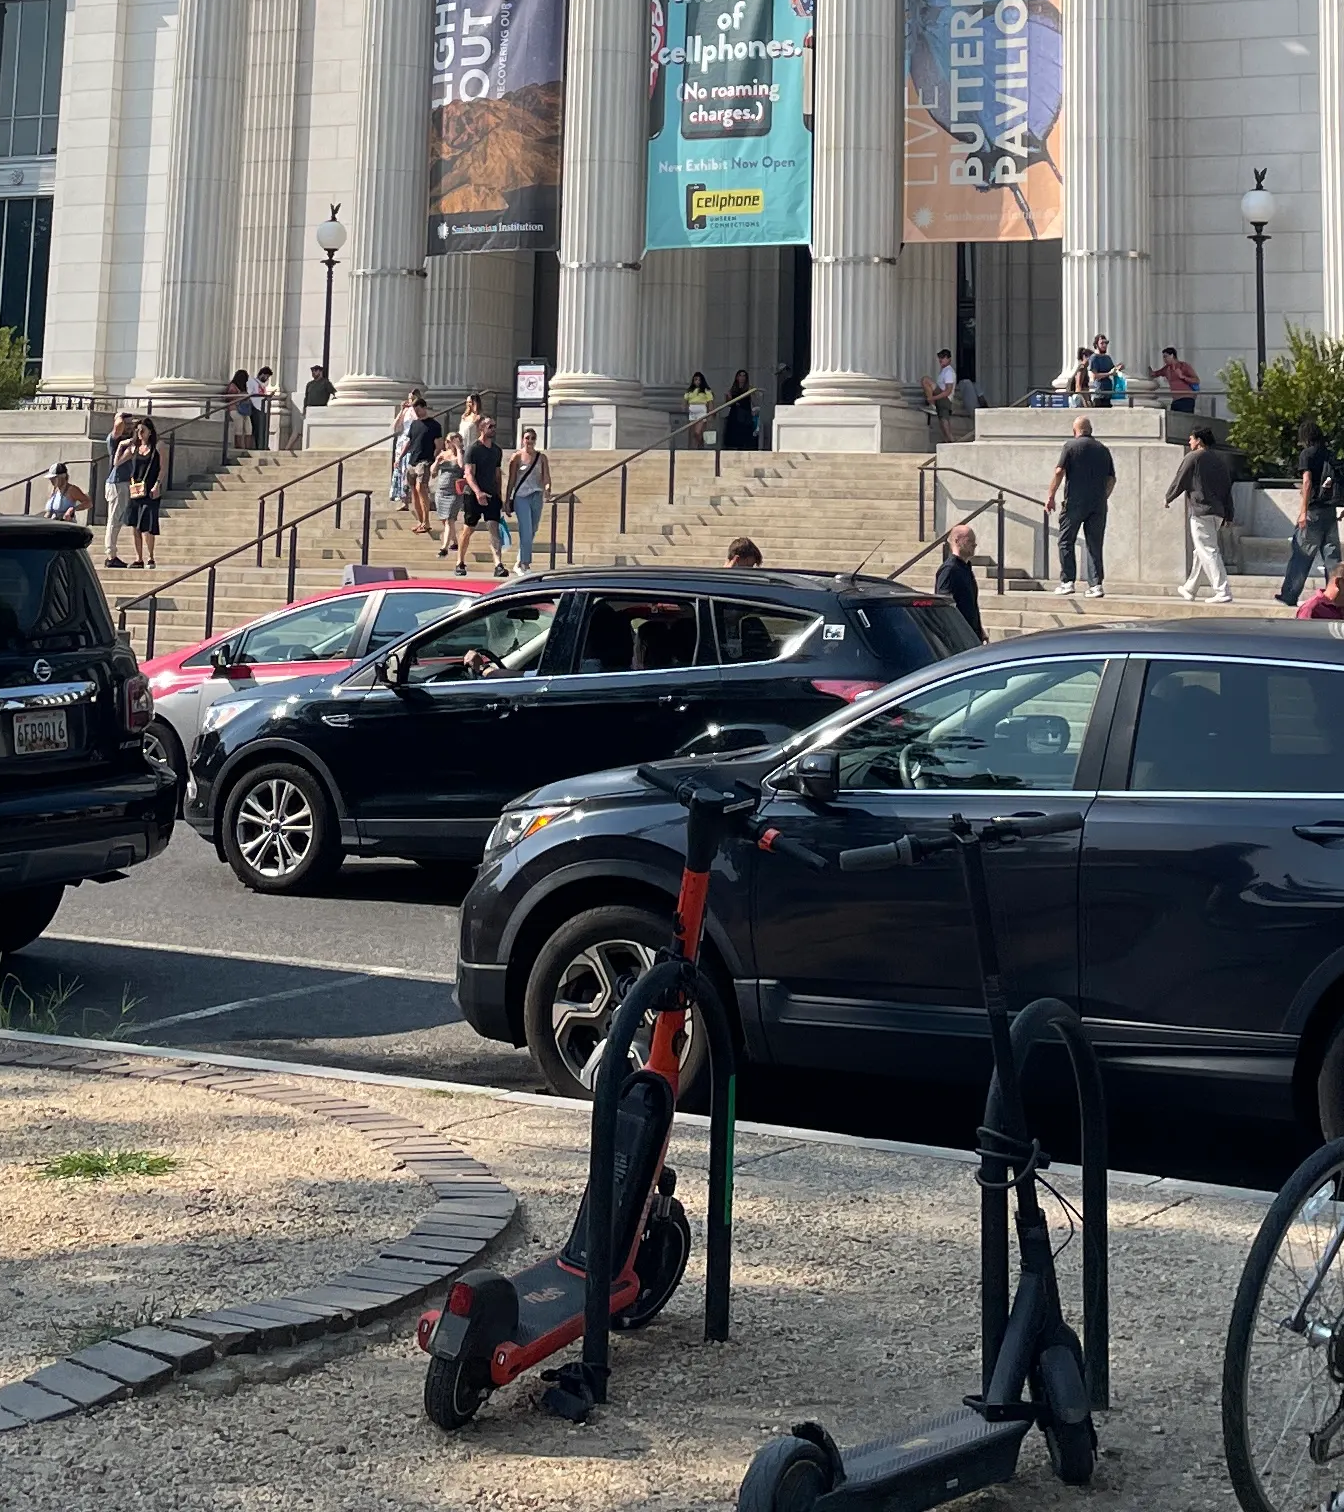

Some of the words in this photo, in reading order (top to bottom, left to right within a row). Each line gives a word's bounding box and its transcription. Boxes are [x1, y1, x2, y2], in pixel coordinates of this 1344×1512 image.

[500, 3, 513, 26] OUR
[717, 0, 746, 31] of
[459, 8, 493, 103] OUT
[496, 29, 511, 100] RECOVERING
[658, 33, 803, 74] cellphones.
[676, 80, 708, 102] (No
[711, 78, 780, 102] roaming
[689, 101, 764, 128] charges.)
[905, 85, 939, 187] LIVE
[685, 158, 729, 173] Exhibit
[731, 156, 758, 170] Now
[762, 155, 796, 173] Open
[696, 192, 761, 211] cellphone
[451, 222, 497, 234] Smithsonian
[499, 221, 544, 232] Institution
